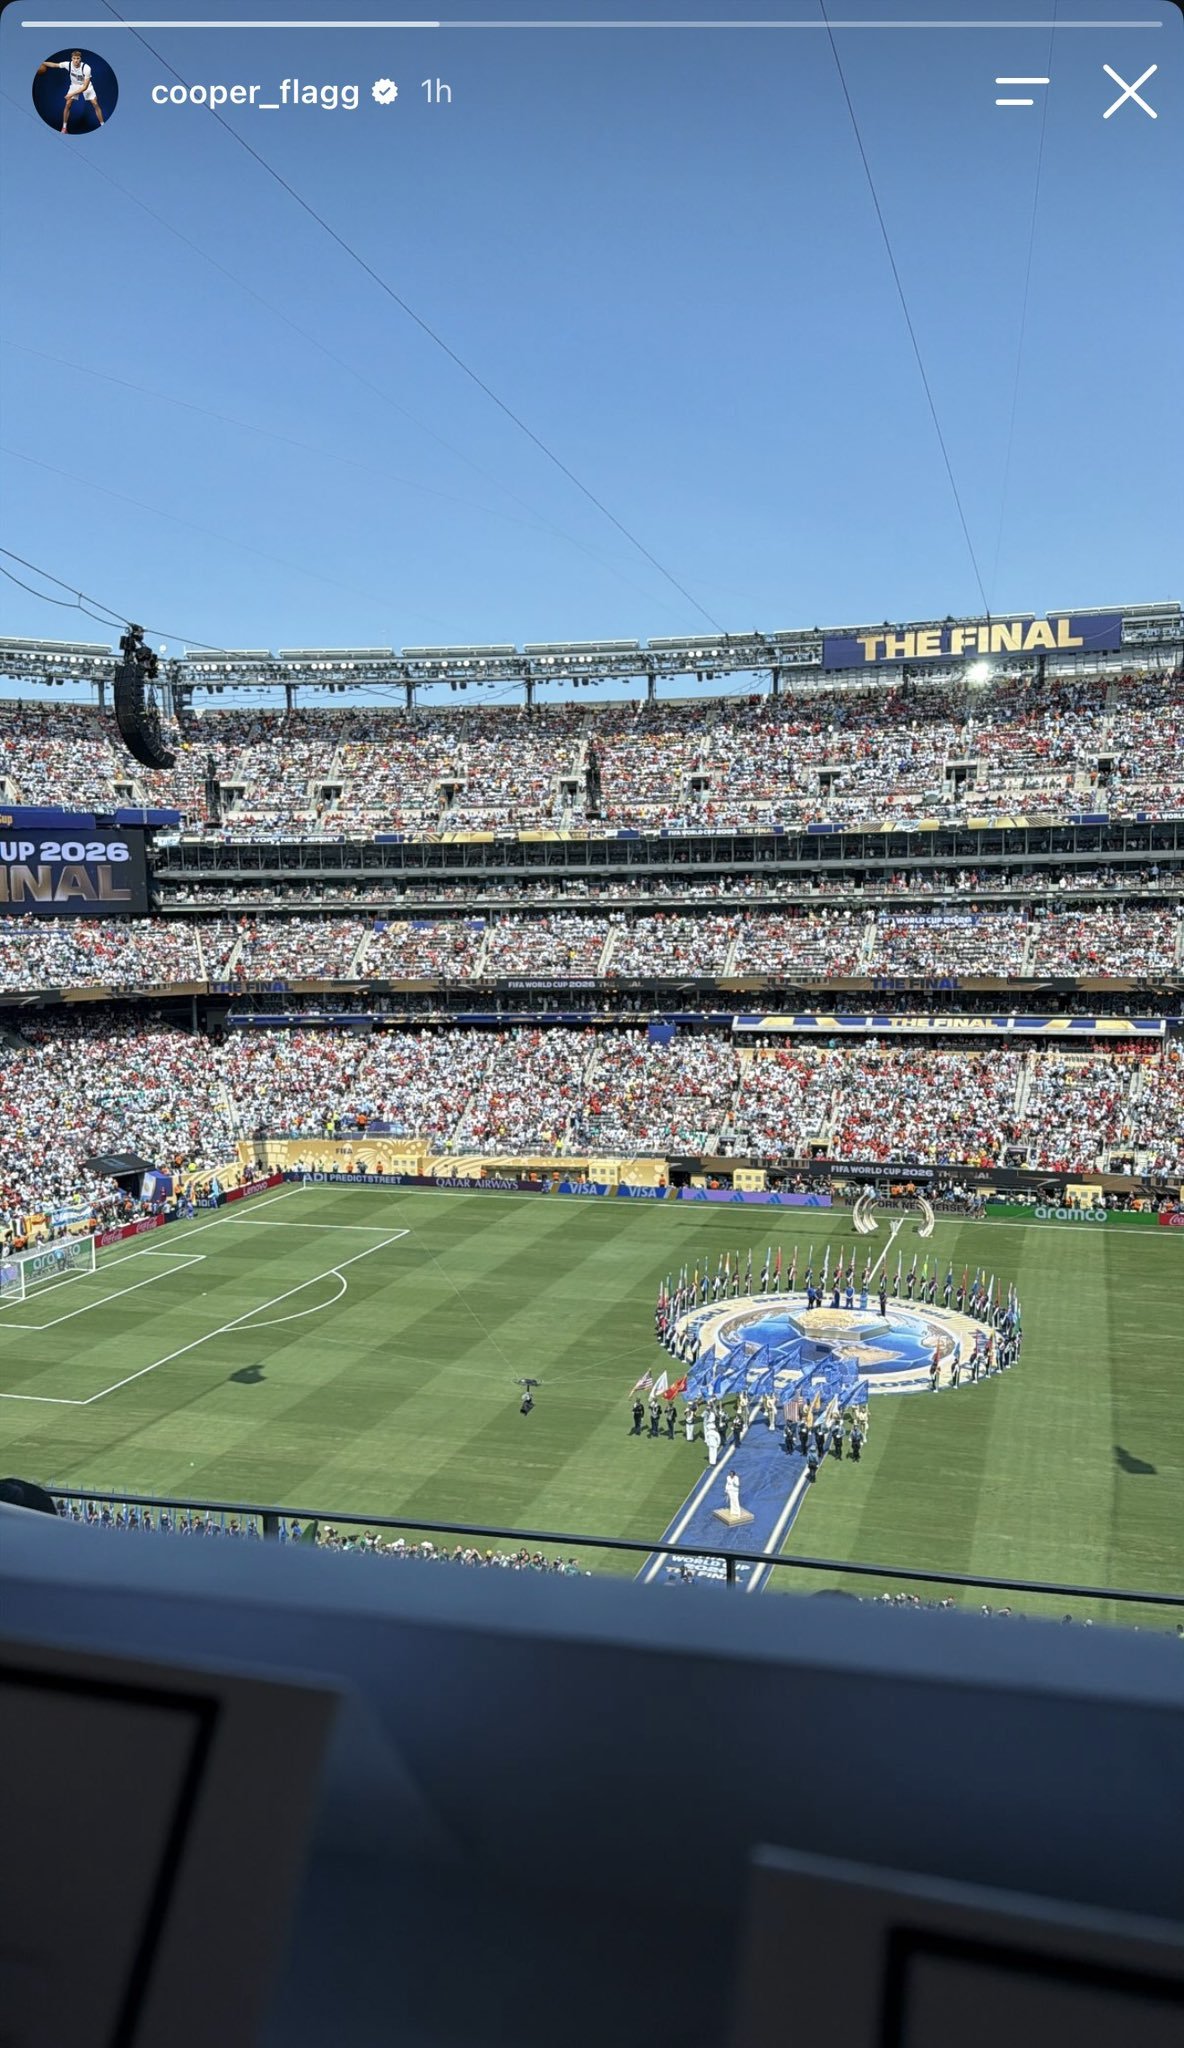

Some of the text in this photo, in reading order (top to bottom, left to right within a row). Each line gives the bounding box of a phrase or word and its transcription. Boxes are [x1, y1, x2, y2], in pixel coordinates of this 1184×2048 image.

[857, 619, 1083, 661] THE FINAL
[40, 841, 130, 862] 2026
[897, 916, 926, 924] WORLD
[927, 916, 942, 924] CUP
[211, 980, 293, 993] THE FINAL
[508, 981, 525, 989] FIFA
[526, 981, 551, 989] WORLD
[553, 981, 568, 989] CUP
[870, 976, 963, 990] THE FINAL
[888, 1017, 999, 1028] THE FINAL
[830, 1165, 850, 1174] FIFA
[851, 1166, 882, 1174] WORLD
[883, 1167, 900, 1175] CUP
[902, 1168, 935, 1177] 2026
[305, 1173, 402, 1184] ADI PREDICTSTREET
[436, 1177, 518, 1191] QATAR AIRWAYS
[243, 1181, 268, 1196] Lenovo
[569, 1183, 597, 1195] VISA
[628, 1186, 656, 1198] VISA
[1035, 1205, 1107, 1222] aramco
[672, 1555, 721, 1567] WORLD
